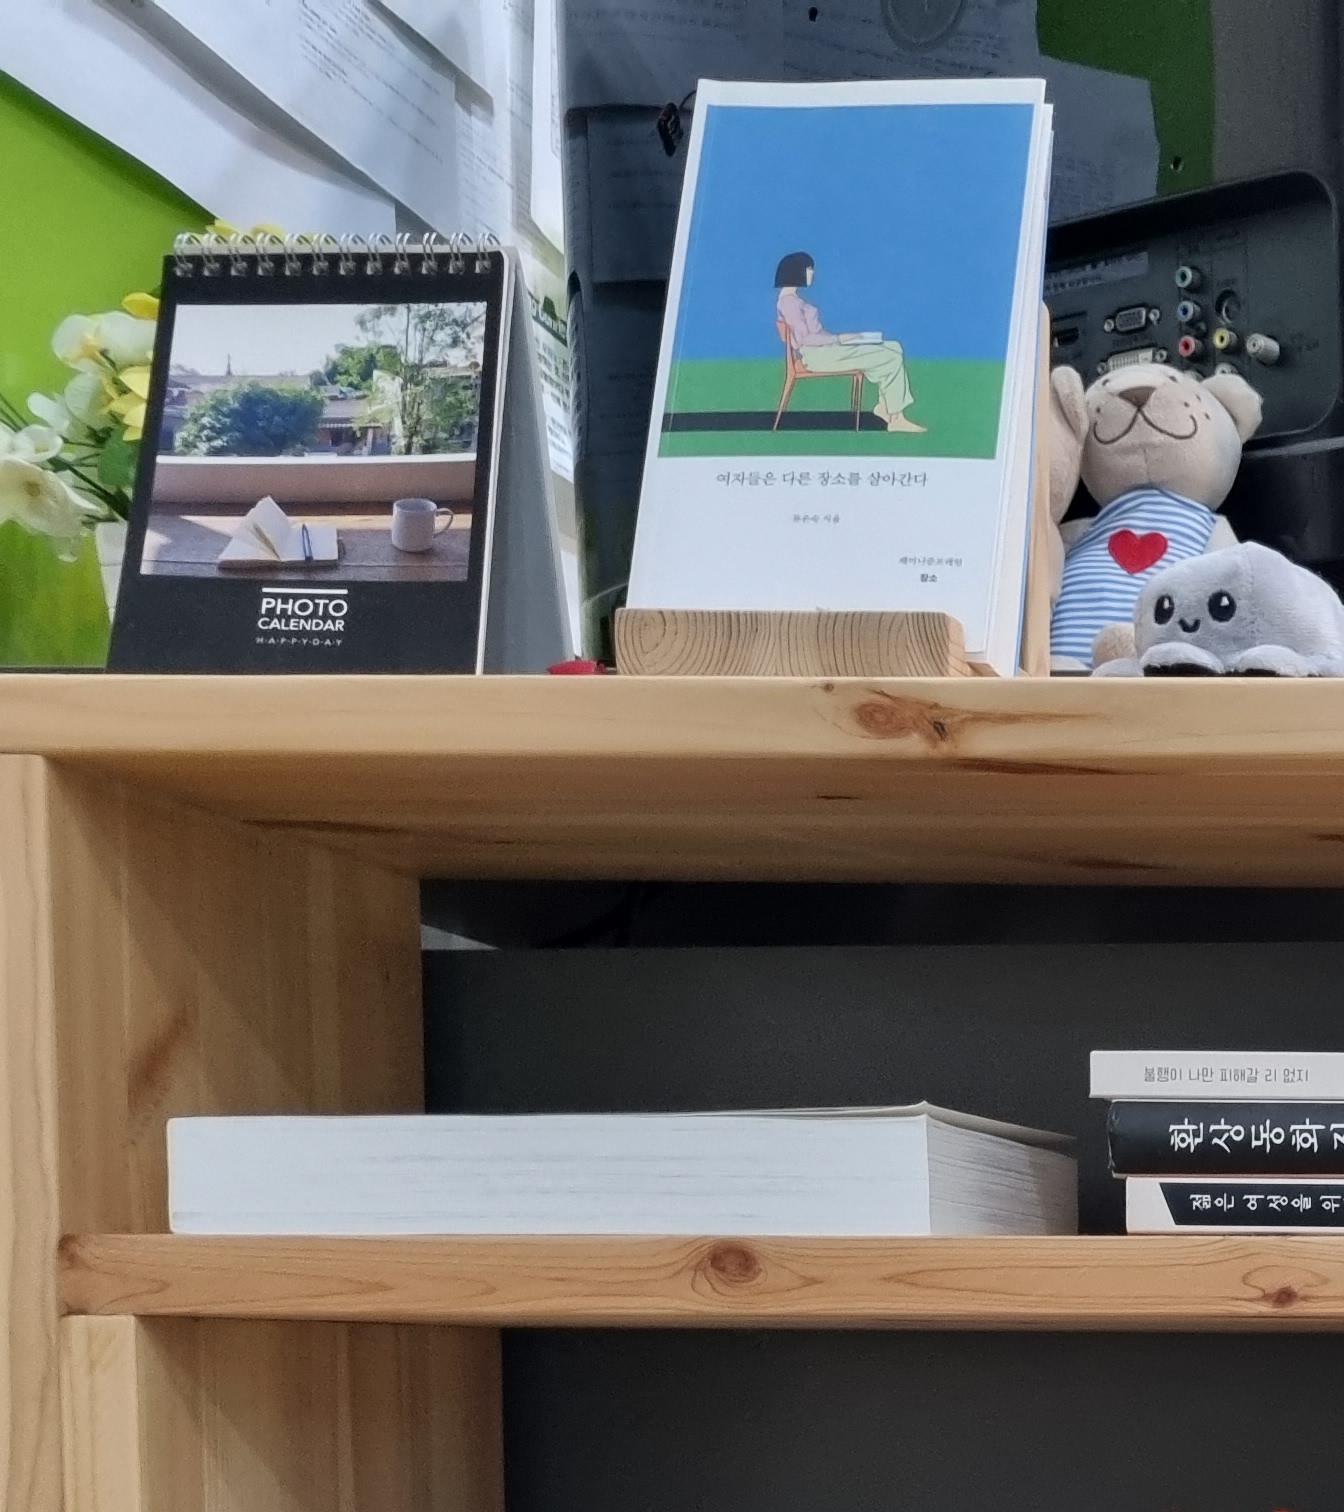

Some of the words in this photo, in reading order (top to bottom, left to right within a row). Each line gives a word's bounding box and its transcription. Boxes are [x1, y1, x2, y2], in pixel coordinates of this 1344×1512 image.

[716, 471, 777, 487] 여자들은
[782, 472, 811, 487] 다른
[817, 471, 862, 486] 장소를
[868, 471, 928, 487] 살아간다
[260, 597, 348, 618] PHOTO
[257, 617, 346, 632] CALENDAR
[1189, 1066, 1214, 1082] 나만
[1265, 1067, 1277, 1082] 리
[1283, 1067, 1309, 1083] 없지
[1189, 1193, 1234, 1212] 젊은
[1243, 1193, 1312, 1213] 여성을
